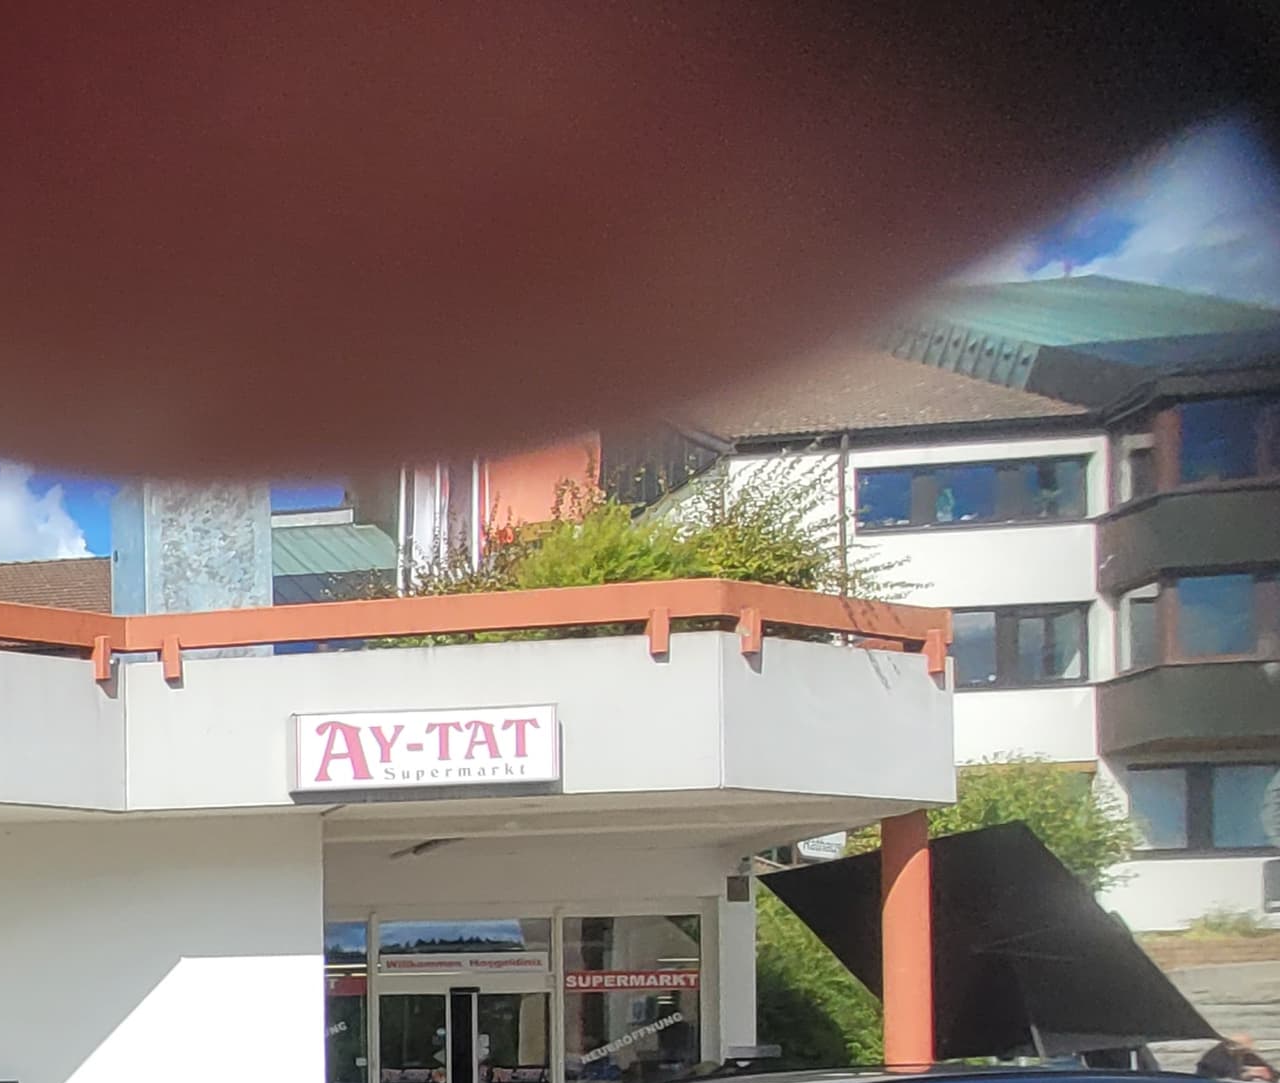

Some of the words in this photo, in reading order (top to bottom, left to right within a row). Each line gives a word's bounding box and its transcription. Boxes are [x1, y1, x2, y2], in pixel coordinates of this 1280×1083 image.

[314, 718, 540, 782] AY-TAT
[383, 762, 527, 781] Supermarkt
[566, 974, 699, 988] SUPERMARKT
